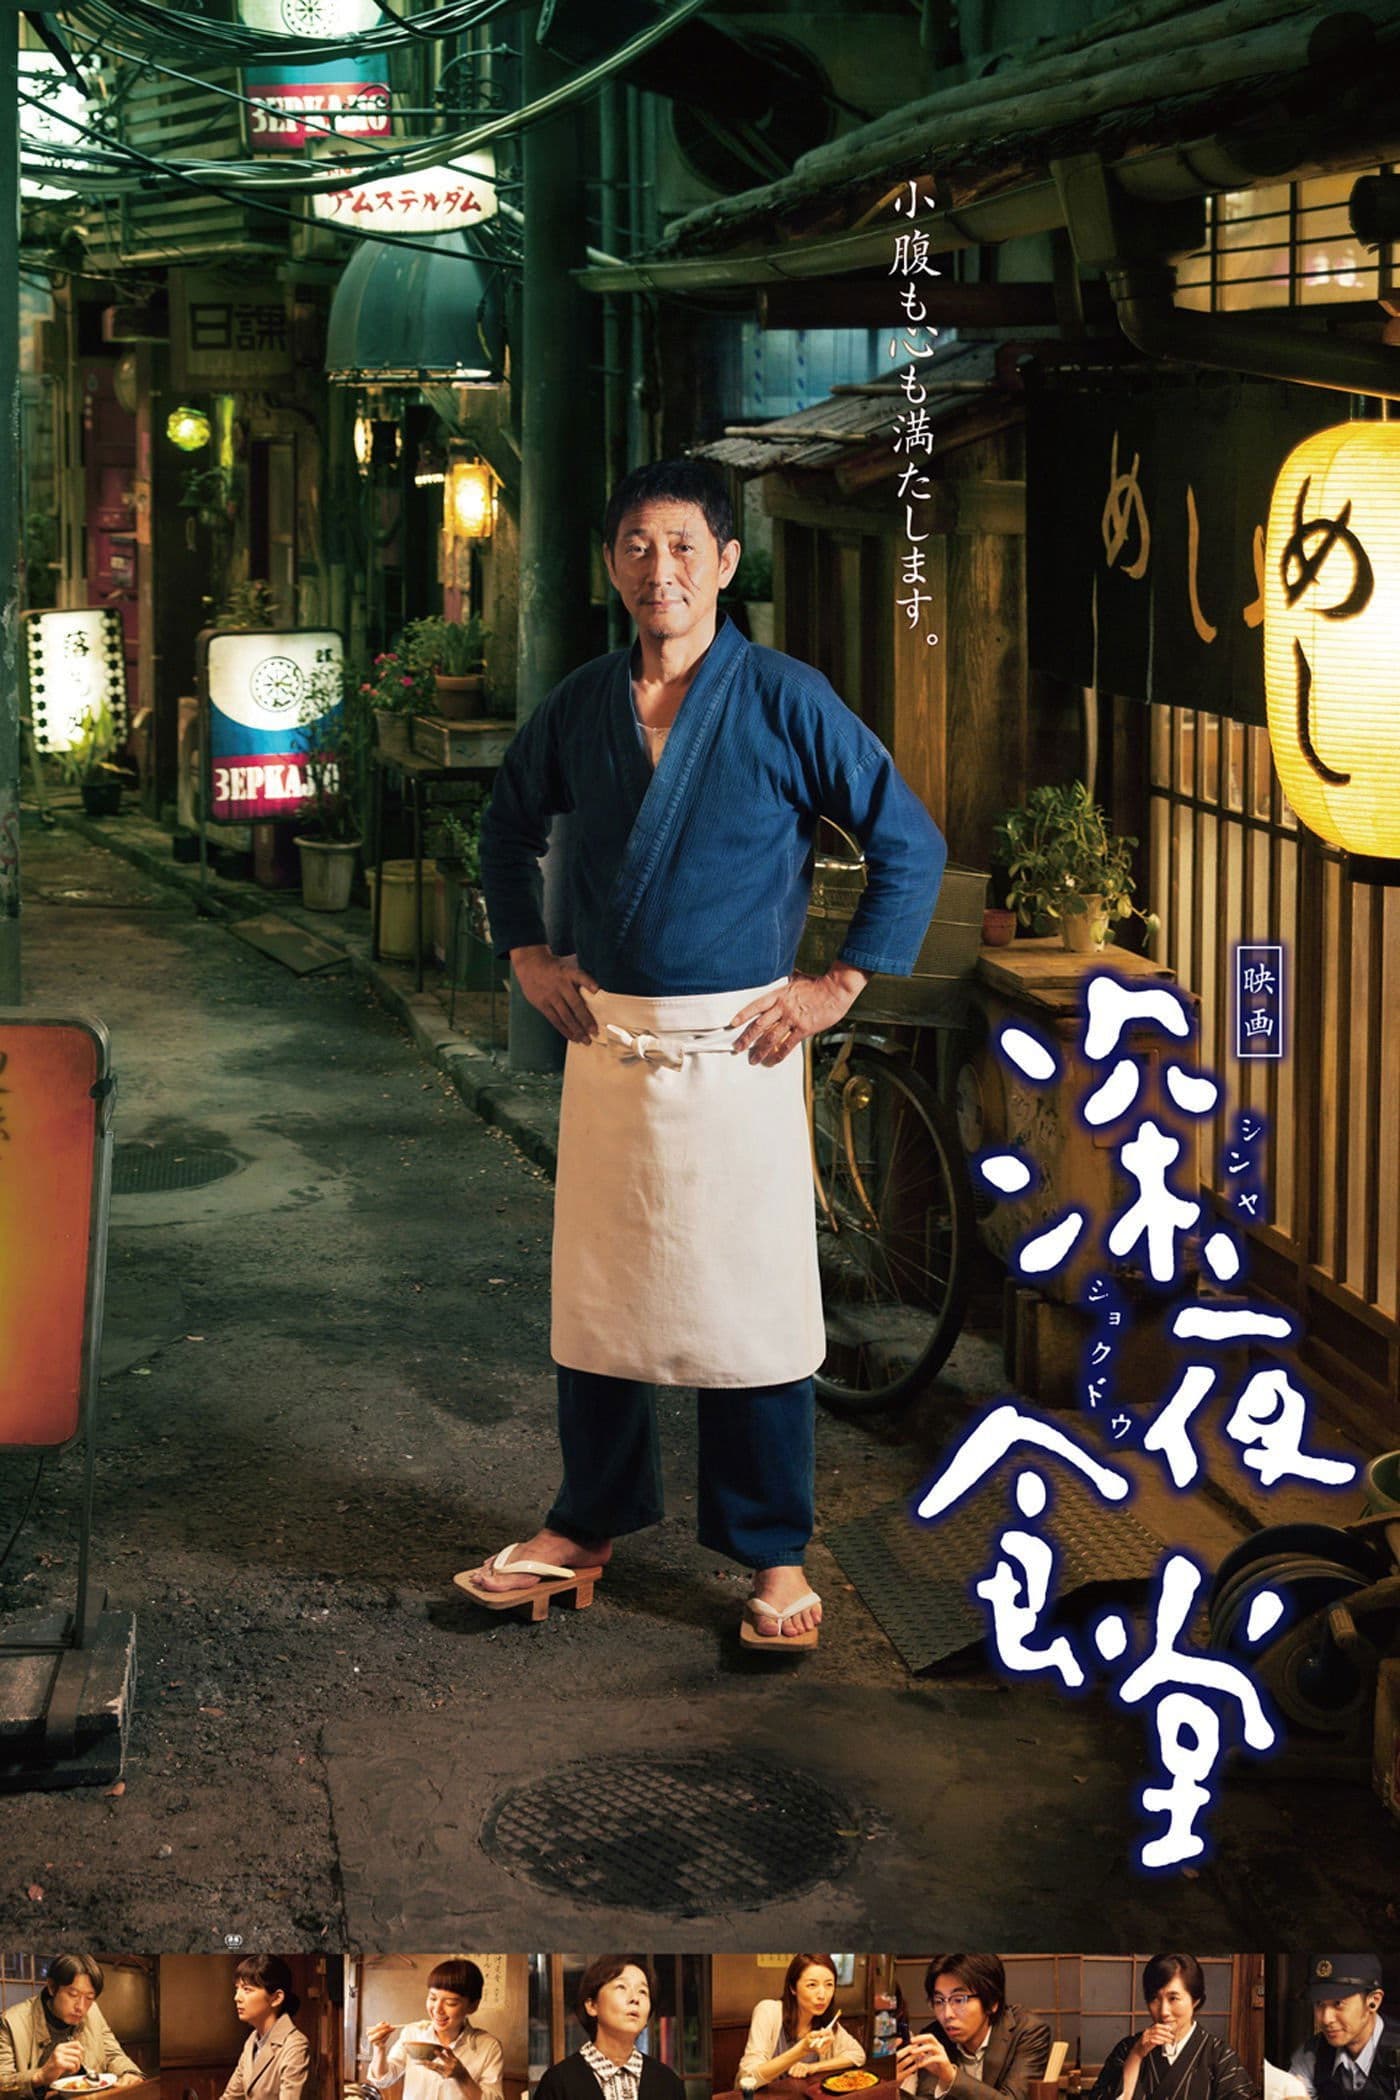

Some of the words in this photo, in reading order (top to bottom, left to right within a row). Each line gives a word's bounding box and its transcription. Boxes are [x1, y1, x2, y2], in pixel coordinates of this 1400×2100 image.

[327, 187, 482, 216] アムステルダム
[1280, 475, 1374, 787] めし
